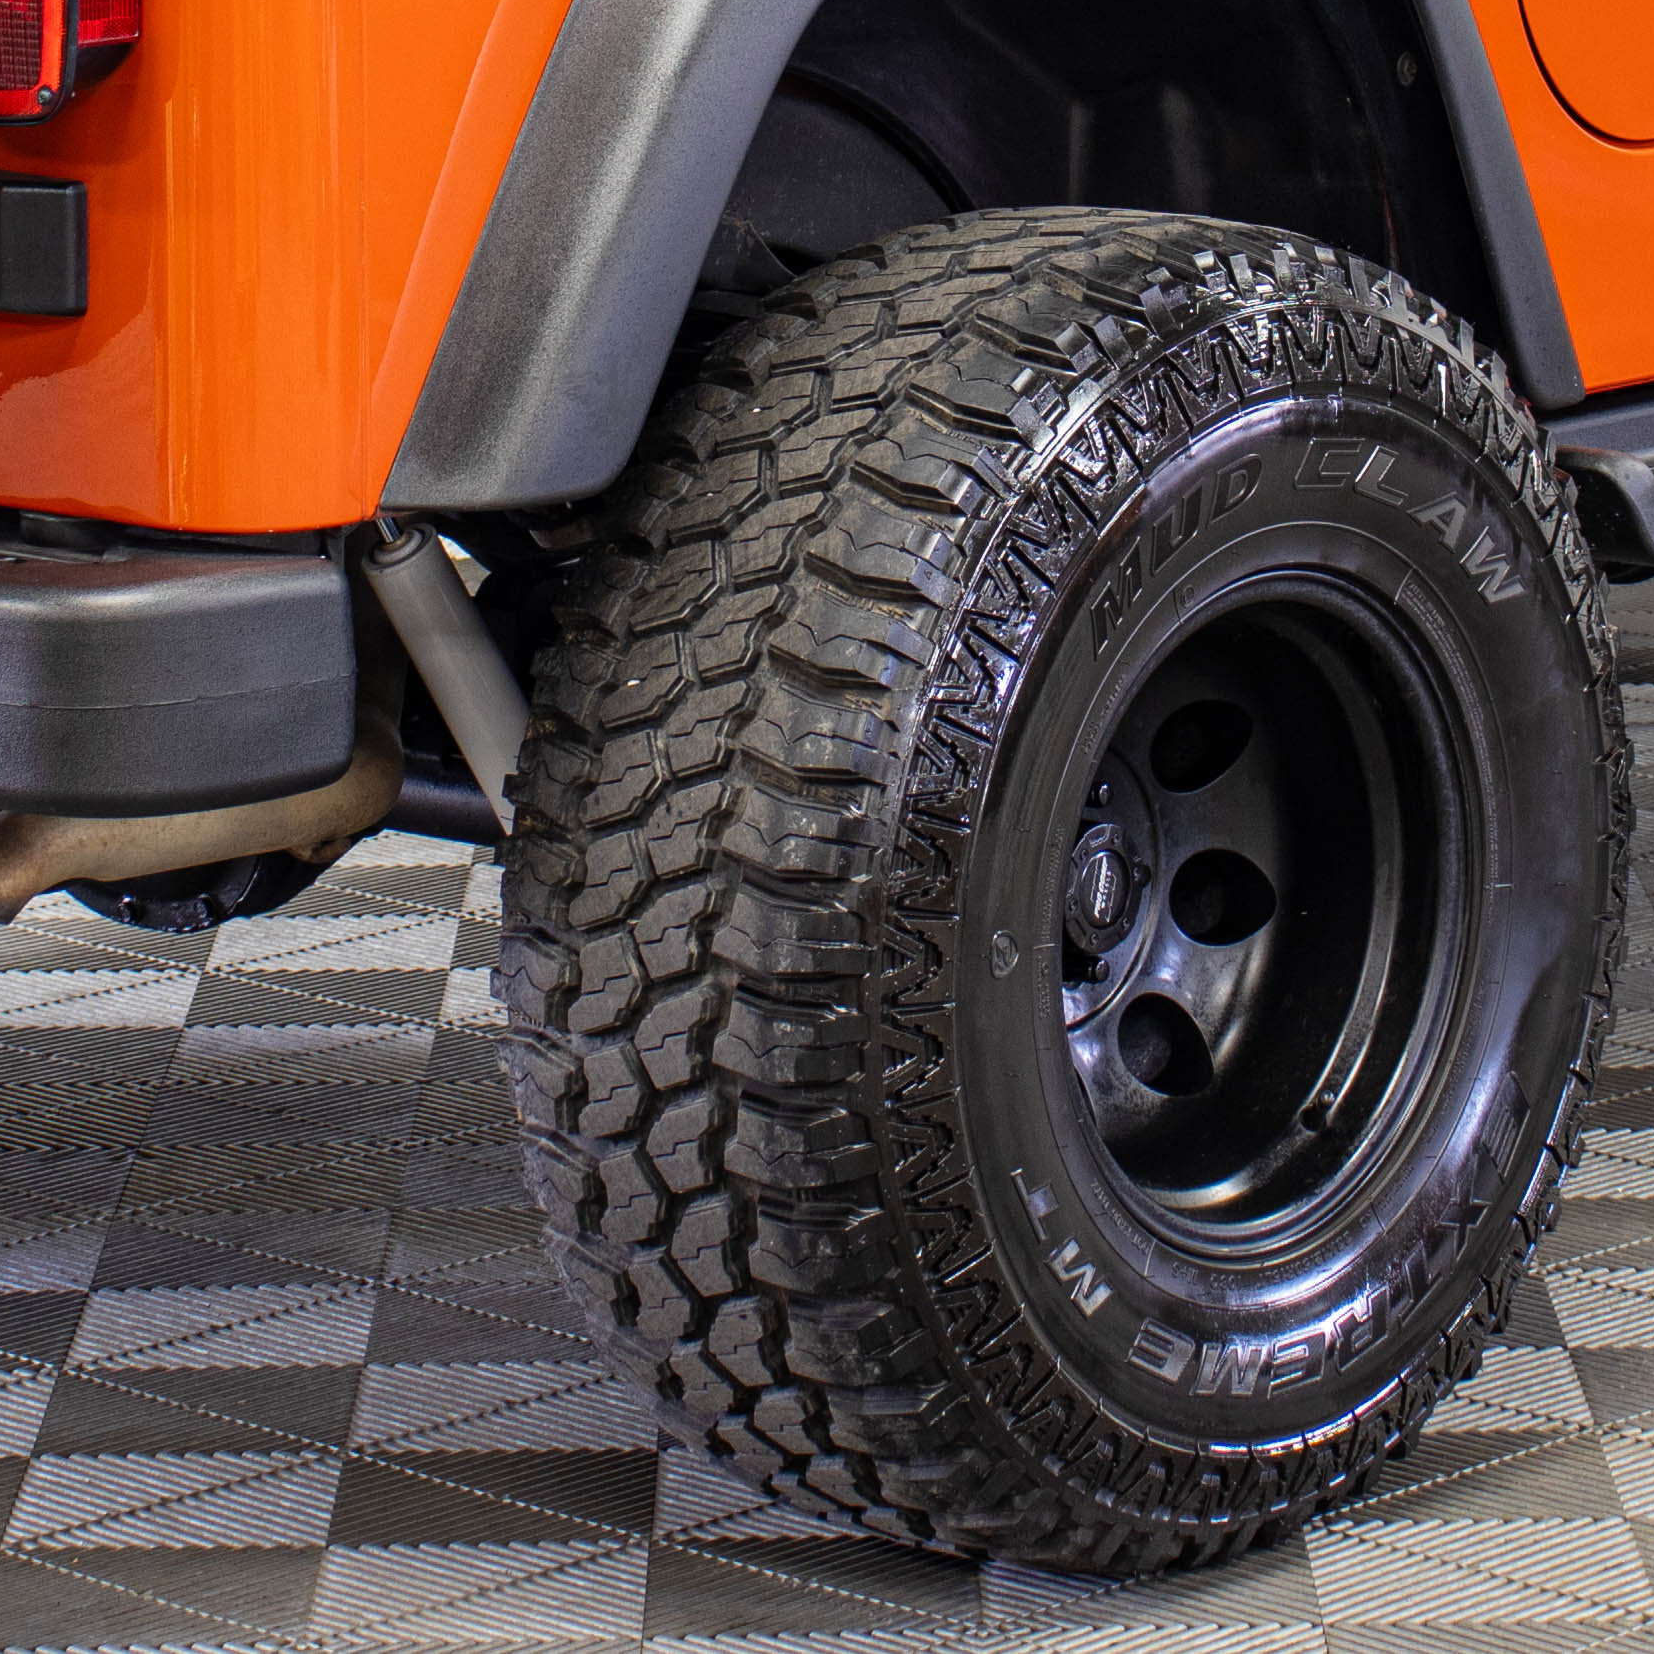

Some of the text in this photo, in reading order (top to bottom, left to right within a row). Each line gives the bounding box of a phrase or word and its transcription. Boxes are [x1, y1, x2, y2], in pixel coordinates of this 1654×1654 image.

[1089, 436, 1530, 662] MUD CLAW
[1010, 1069, 1532, 1400] EXTREME MT
